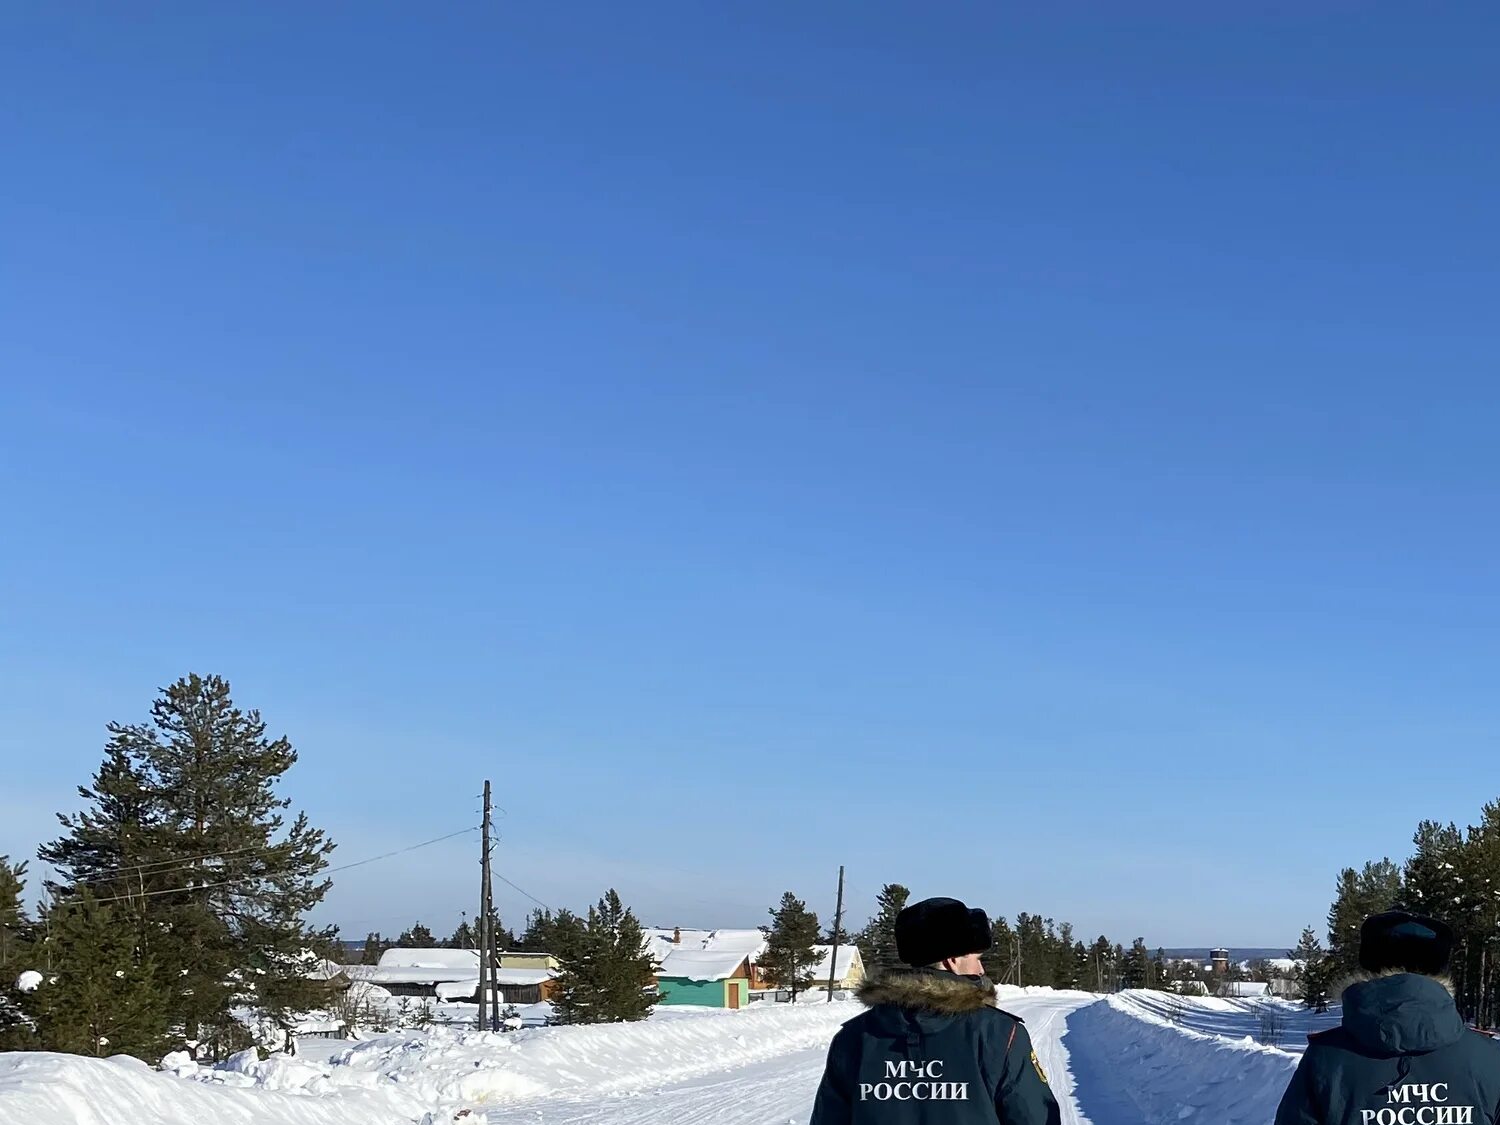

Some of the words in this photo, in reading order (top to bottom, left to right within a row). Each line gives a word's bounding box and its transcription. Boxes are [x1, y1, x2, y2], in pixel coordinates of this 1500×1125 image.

[884, 1060, 943, 1078] МЧС
[859, 1082, 969, 1100] РОССИИ
[1386, 1083, 1448, 1103] МЧС
